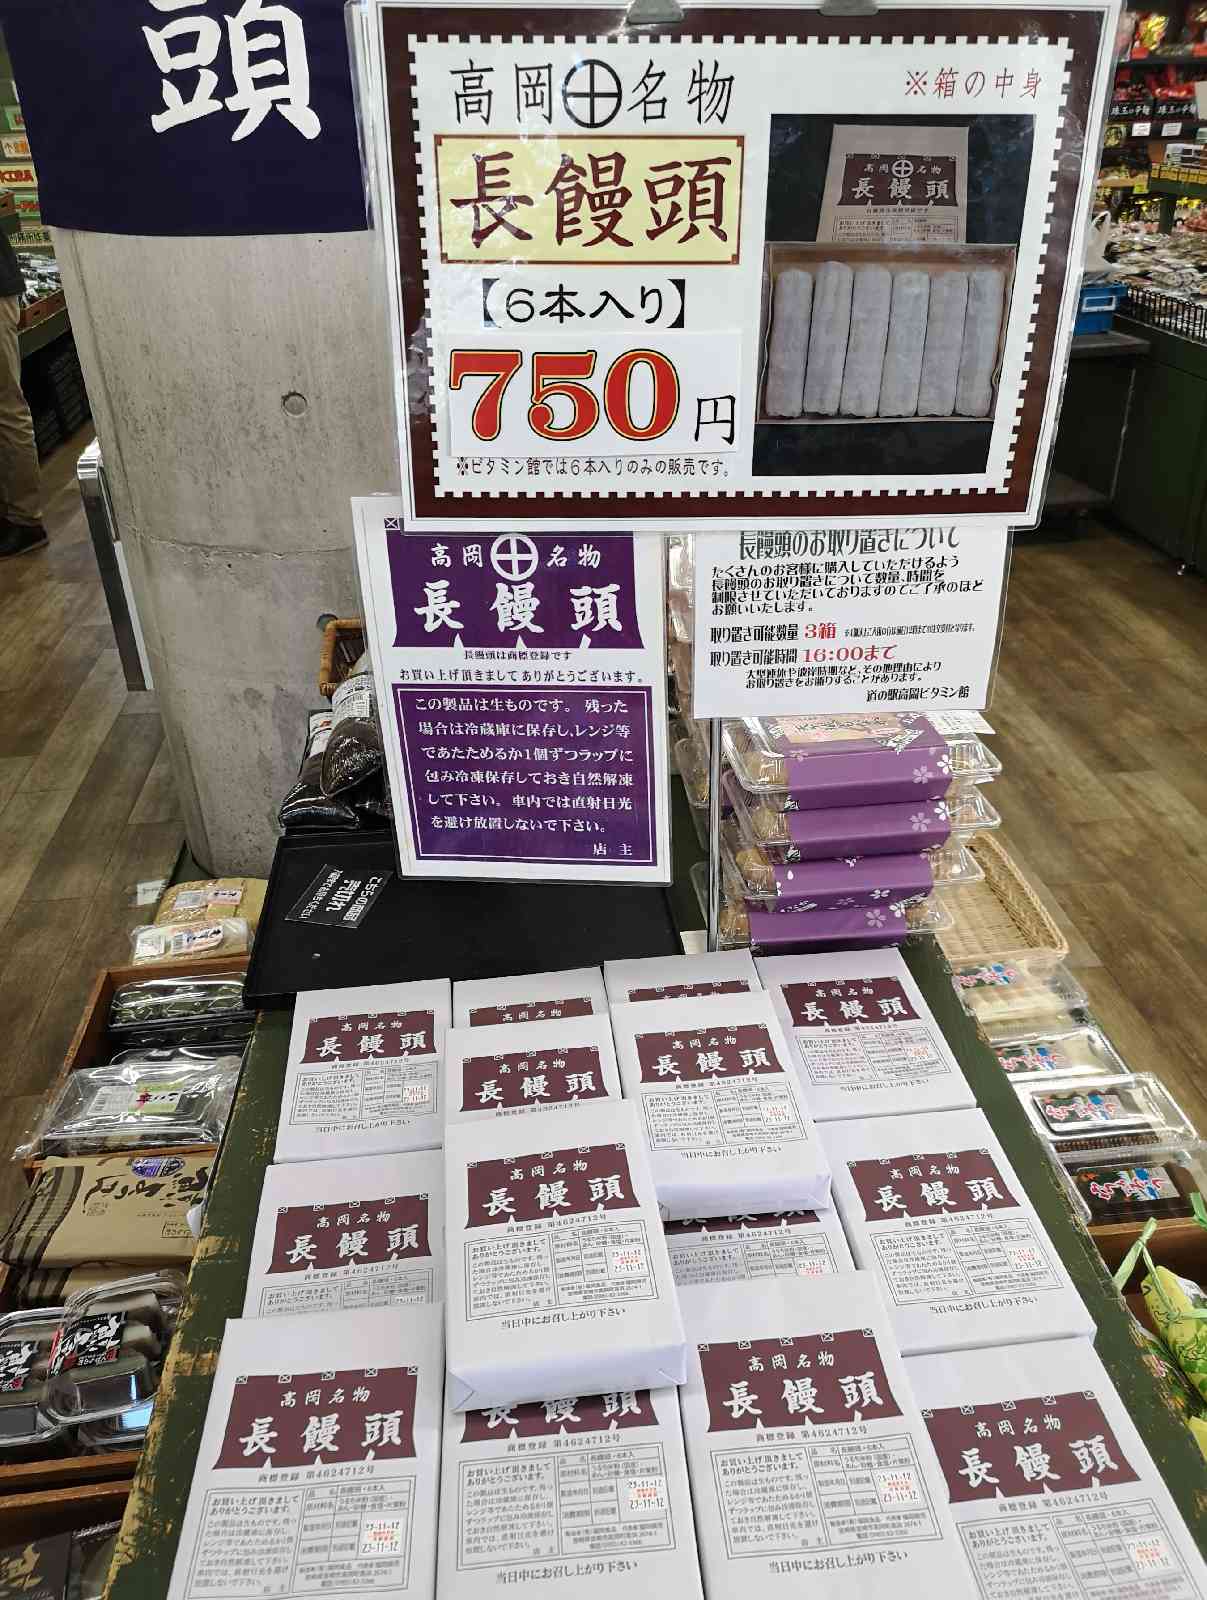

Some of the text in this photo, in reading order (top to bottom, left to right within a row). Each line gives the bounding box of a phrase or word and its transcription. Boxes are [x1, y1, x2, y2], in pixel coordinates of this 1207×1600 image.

[142, 0, 322, 141] 頭
[905, 68, 1044, 99] ※箱の中身
[451, 150, 732, 249] 長饅頭
[852, 177, 949, 200] 長饅頭
[712, 555, 960, 578] たくさんのお客様に購入していただけるよう
[414, 579, 623, 634] 長饅頭
[712, 601, 814, 615] お願いいたします。
[710, 624, 799, 644] 取り置き可能数量
[463, 650, 573, 661] 長饅頭は商標登録です
[710, 648, 798, 667] 取り置き可能時間
[866, 685, 971, 702] 道の駅高岡ビタミン館
[418, 722, 632, 739] 場合は冷蔵庫に保存し、レンジ等
[424, 770, 633, 788] 包み冷凍保存しておき自然解凍
[431, 816, 606, 834] を避け放置しないで下さい。
[801, 997, 908, 1022] 長饅頭
[317, 1031, 428, 1058] 長饅頭
[652, 1047, 772, 1077] 長饅頭
[474, 1071, 597, 1104] 長饅頭
[510, 1160, 588, 1181] 高岡名物
[890, 1164, 960, 1181] 高岡名物
[482, 1174, 625, 1217] 長饅頭
[874, 1176, 1004, 1213] 長饅頭
[317, 1211, 391, 1228] 高岡名物
[285, 1224, 419, 1264] 長饅頭
[749, 1351, 835, 1372] 高岡名物
[280, 1386, 371, 1409] 高岡名物
[723, 1371, 884, 1418] 長饅頭
[238, 1410, 404, 1457] 長饅頭
[975, 1414, 1061, 1438] 高岡名物
[958, 1434, 1119, 1488] 長饅頭
[496, 1561, 639, 1584] 当日中にお召し上がり下さい
[769, 1550, 908, 1574] 当日中にお召し上がり下さい
